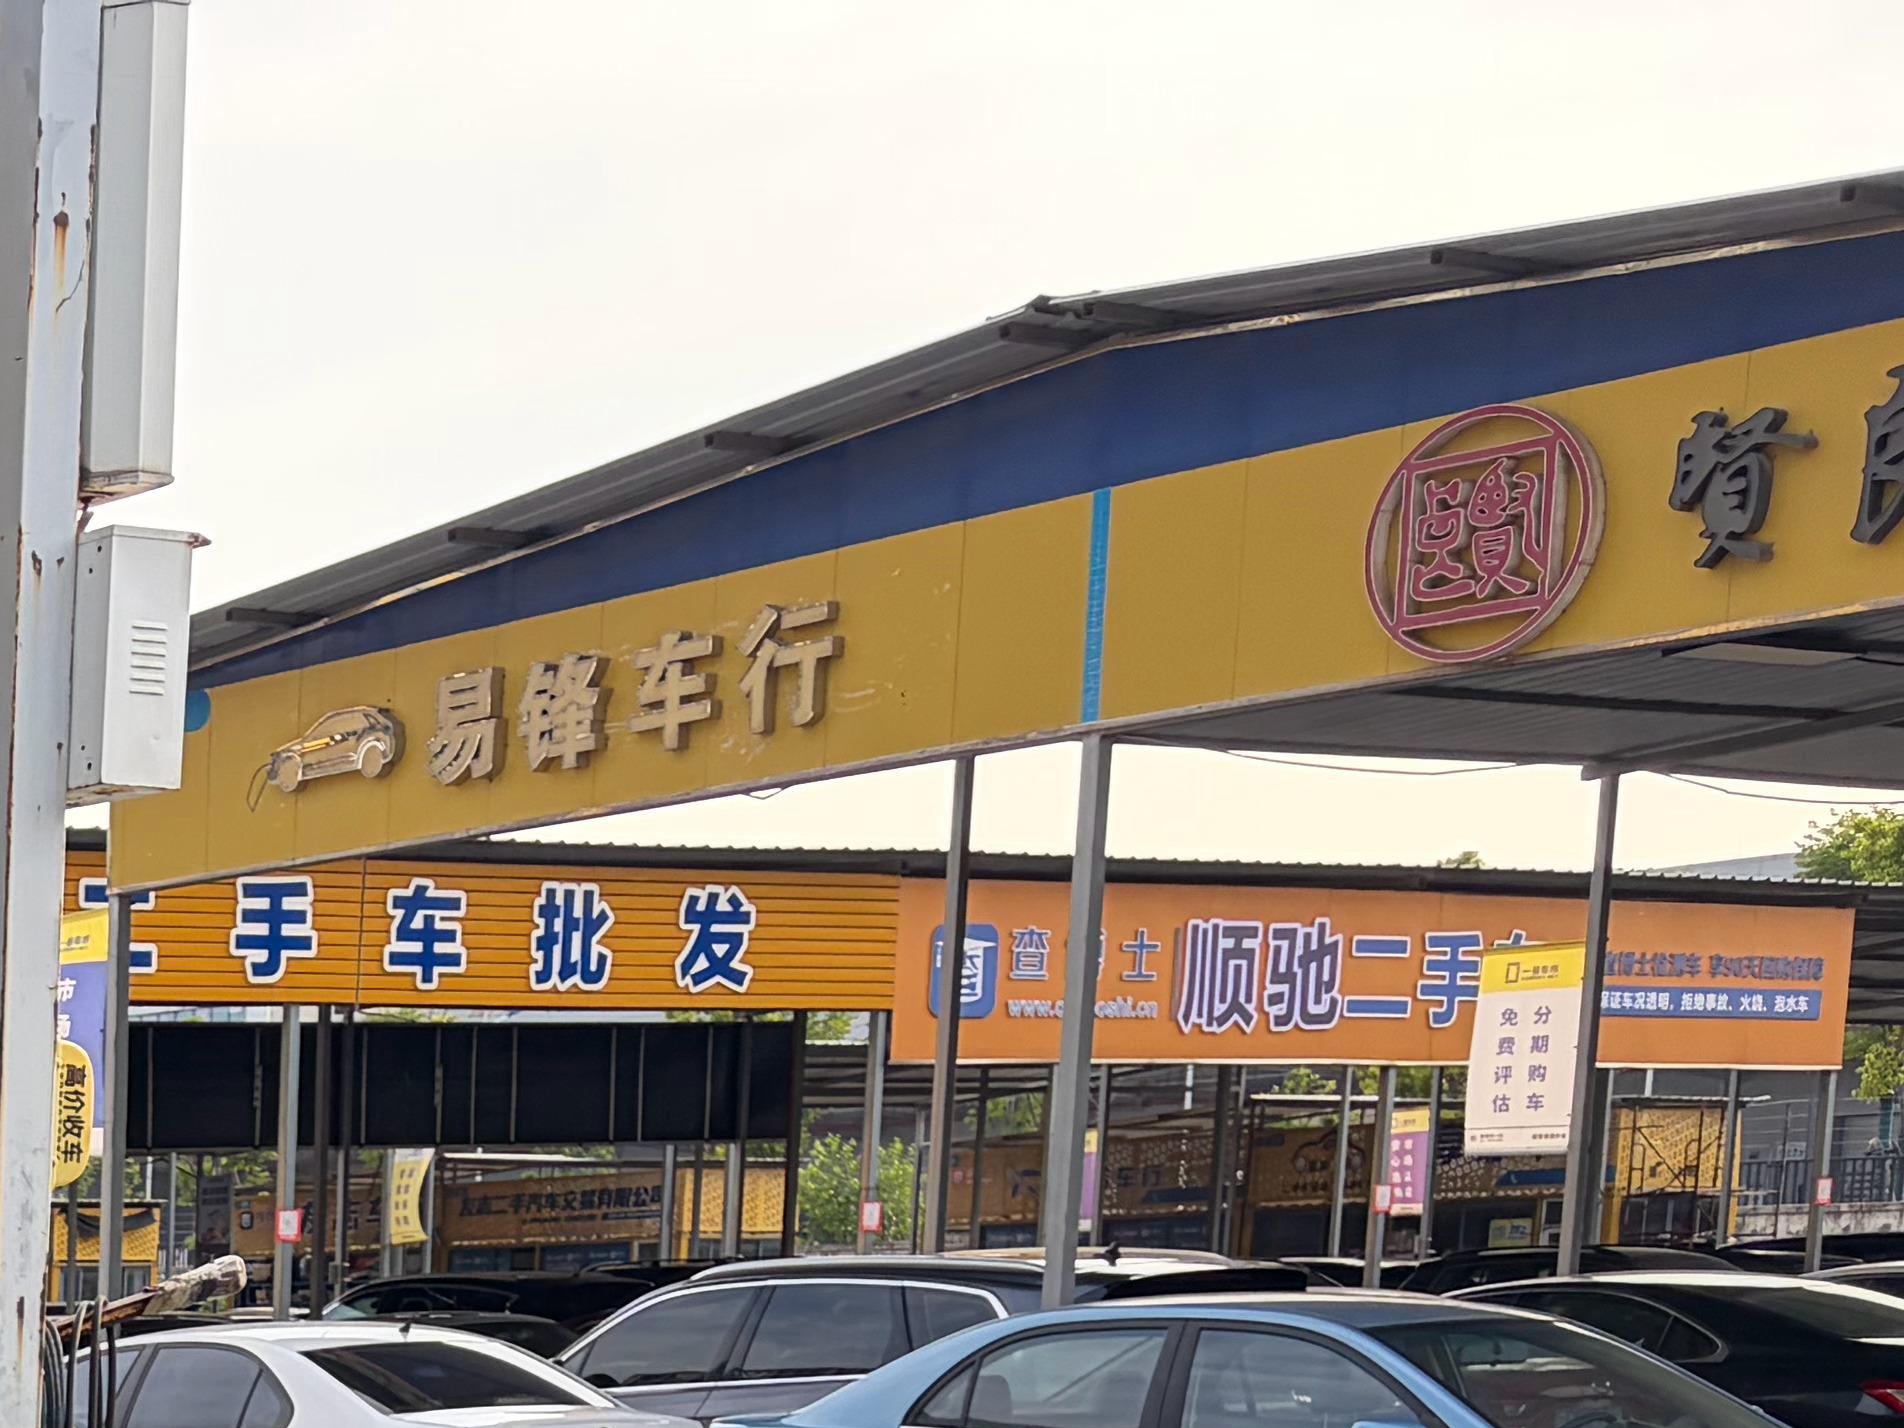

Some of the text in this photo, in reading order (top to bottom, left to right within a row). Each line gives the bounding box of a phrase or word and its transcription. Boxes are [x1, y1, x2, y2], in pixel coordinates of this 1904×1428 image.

[425, 600, 845, 787] 易锋车行
[79, 875, 758, 995] 二手车批发
[1010, 925, 1162, 982] 查士
[1176, 918, 1532, 1036] 顺驰二手
[1491, 1007, 1520, 1114] 免费评估
[1525, 1004, 1553, 1113] 分期购车
[61, 1062, 88, 1165] 高价收车
